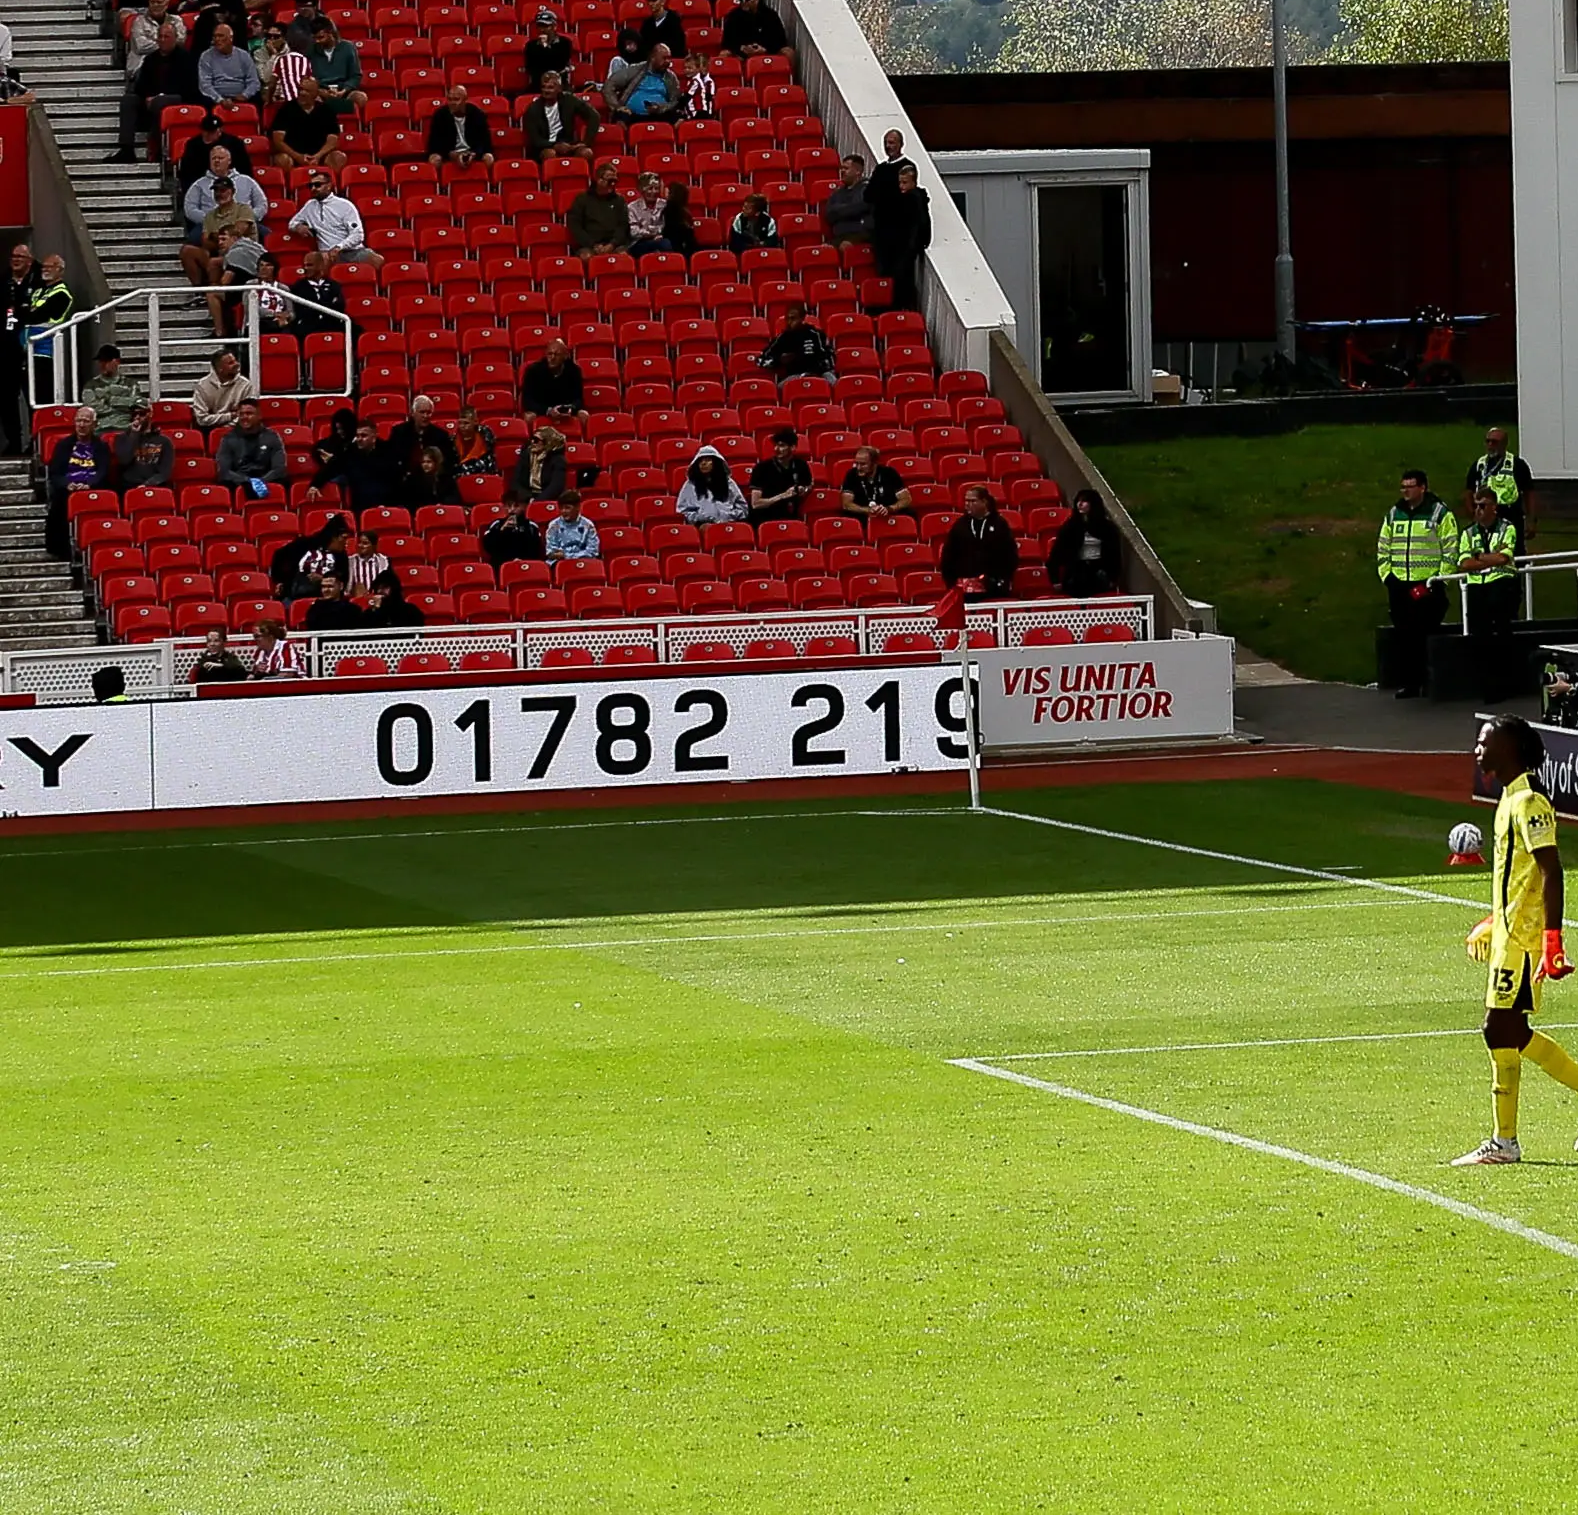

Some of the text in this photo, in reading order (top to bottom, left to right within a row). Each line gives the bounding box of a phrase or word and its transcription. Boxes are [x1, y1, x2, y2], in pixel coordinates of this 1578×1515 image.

[1002, 661, 1158, 696] VIS UNITA
[1032, 691, 1173, 724] FORTIOR
[375, 688, 730, 787] 01782
[0, 733, 94, 789] Y
[1558, 752, 1574, 794] of
[1493, 968, 1514, 993] 13
